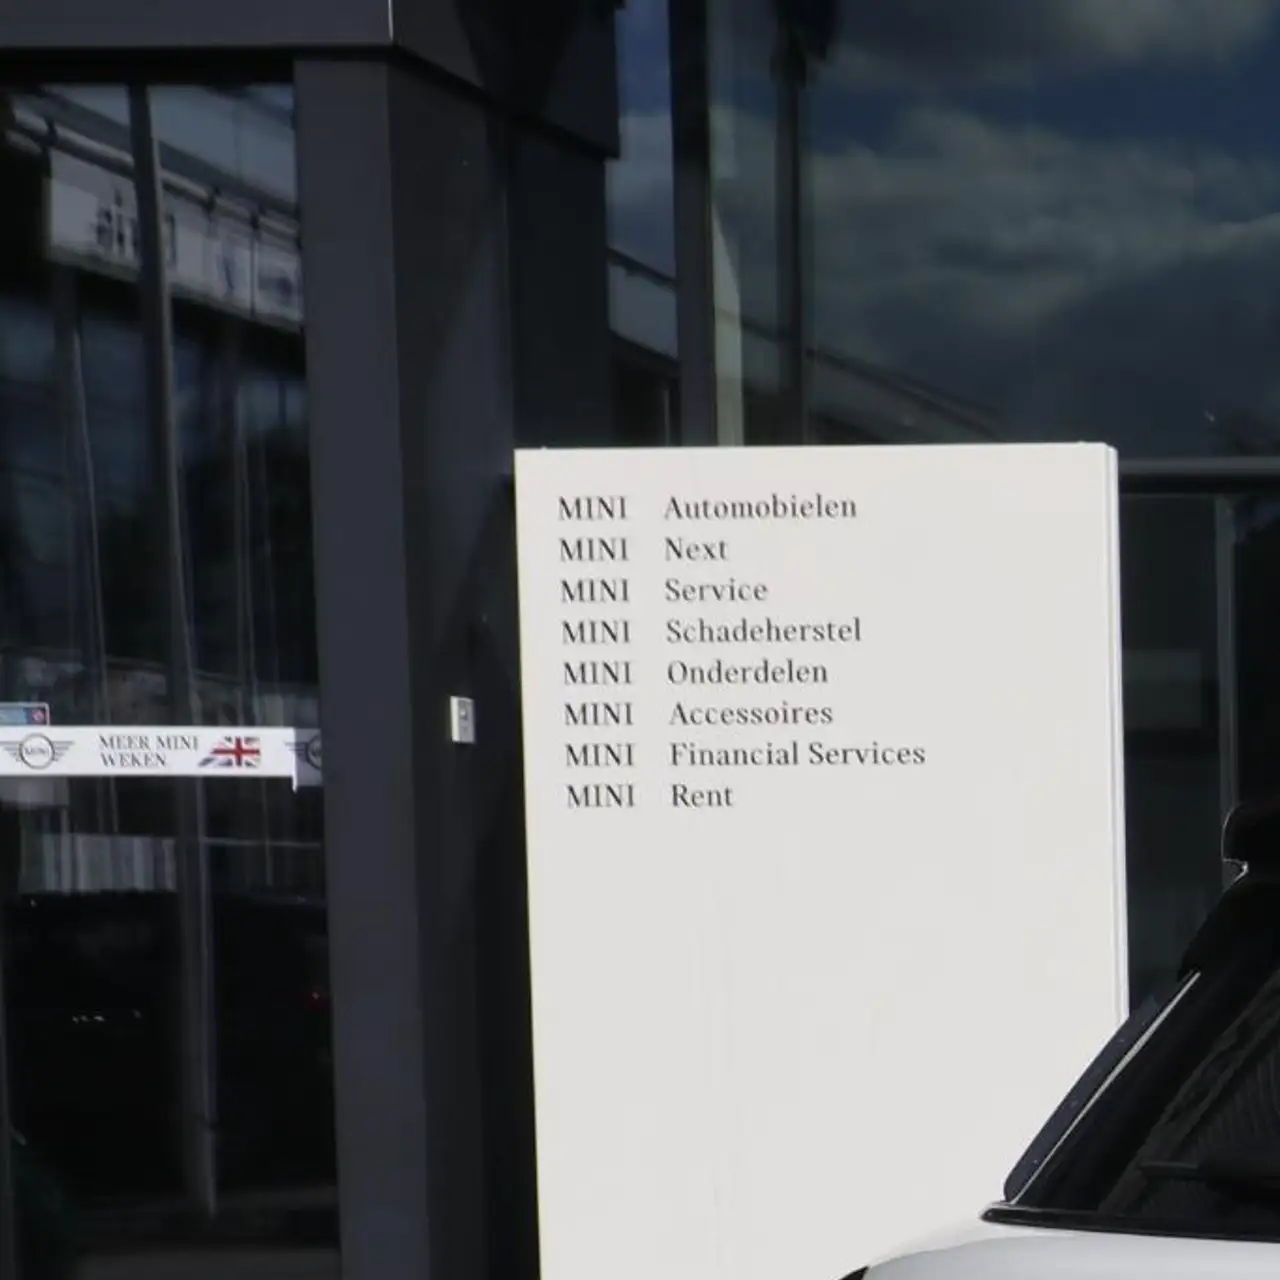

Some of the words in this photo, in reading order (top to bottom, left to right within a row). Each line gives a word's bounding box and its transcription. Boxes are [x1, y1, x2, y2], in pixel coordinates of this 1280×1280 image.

[559, 497, 626, 520] MINI
[665, 494, 857, 520] Automobielen
[559, 537, 629, 562] MINI
[665, 537, 728, 561] Next
[561, 579, 630, 602] MINI
[665, 578, 768, 602] Service
[562, 620, 631, 645] MINI
[666, 618, 861, 643] Schadeherstel
[563, 661, 633, 685] MINI
[667, 659, 828, 684] Onderdelen
[564, 702, 634, 726] MINI
[670, 701, 834, 726] Accessoires
[98, 735, 150, 750] MEER
[156, 736, 199, 751] MINI
[565, 743, 635, 767] MINI
[670, 740, 798, 766] Financial
[808, 741, 926, 766] Services
[100, 752, 166, 767] WEKEN
[566, 784, 635, 808] MINI
[671, 783, 733, 807] Rent
